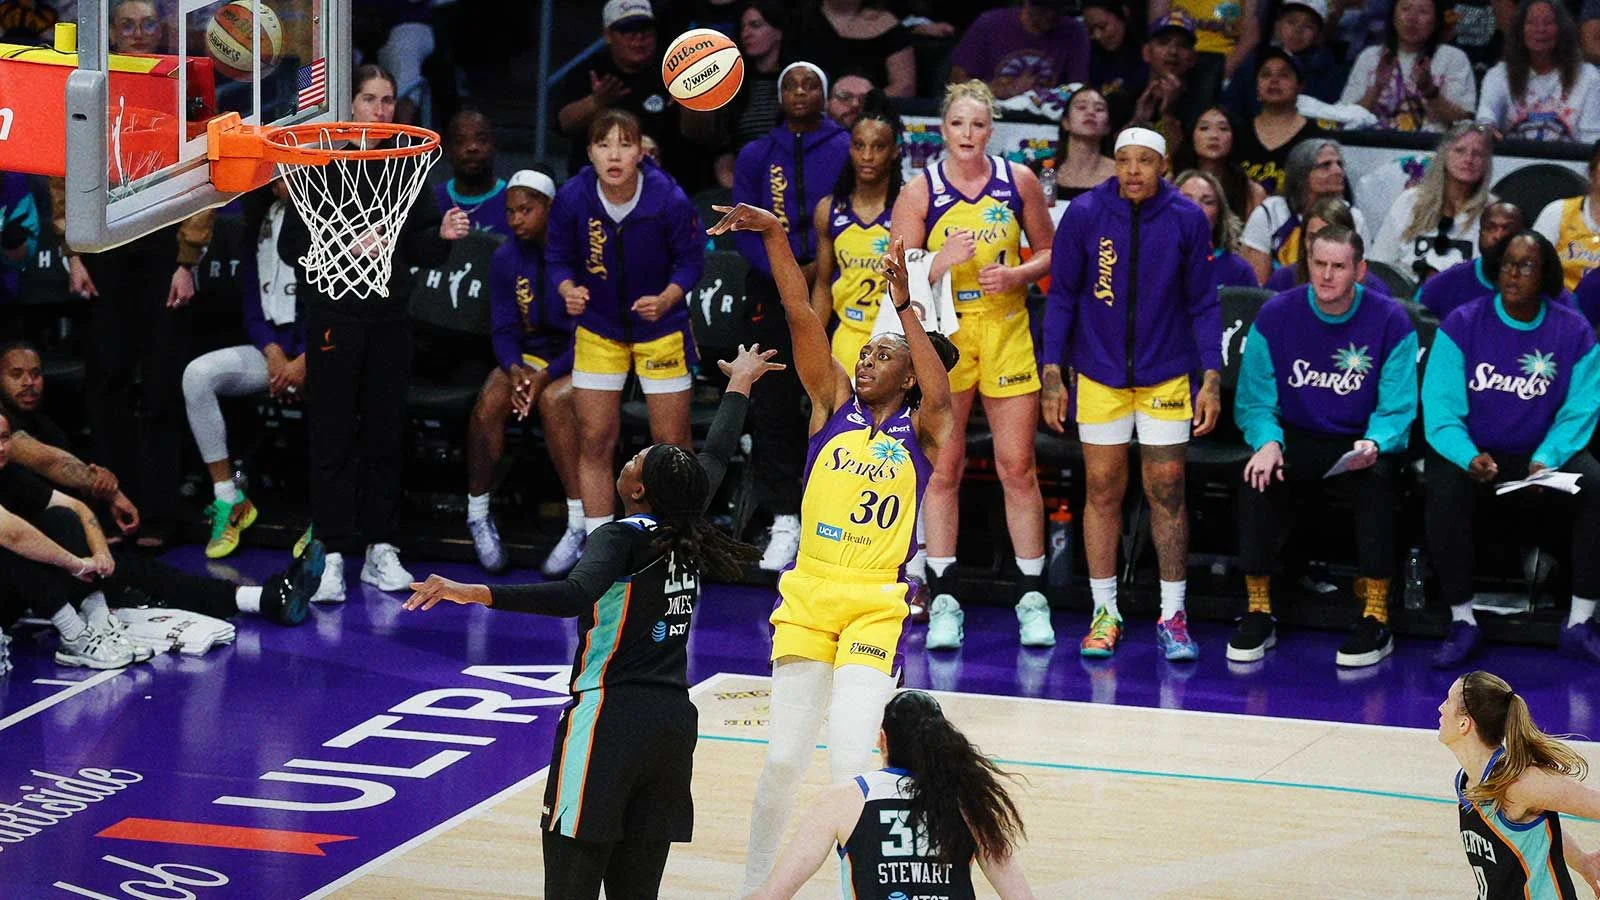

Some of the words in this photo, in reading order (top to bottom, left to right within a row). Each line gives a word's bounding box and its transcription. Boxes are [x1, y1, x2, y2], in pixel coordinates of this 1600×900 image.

[666, 39, 715, 73] Wilson
[691, 63, 721, 86] WNBA
[887, 425, 911, 434] Albert
[850, 490, 900, 530] 30
[819, 526, 840, 539] UCLA
[843, 532, 873, 547] Health
[858, 644, 887, 659] WNBA
[211, 664, 574, 812] ULTRA
[877, 861, 953, 884] STEWART
